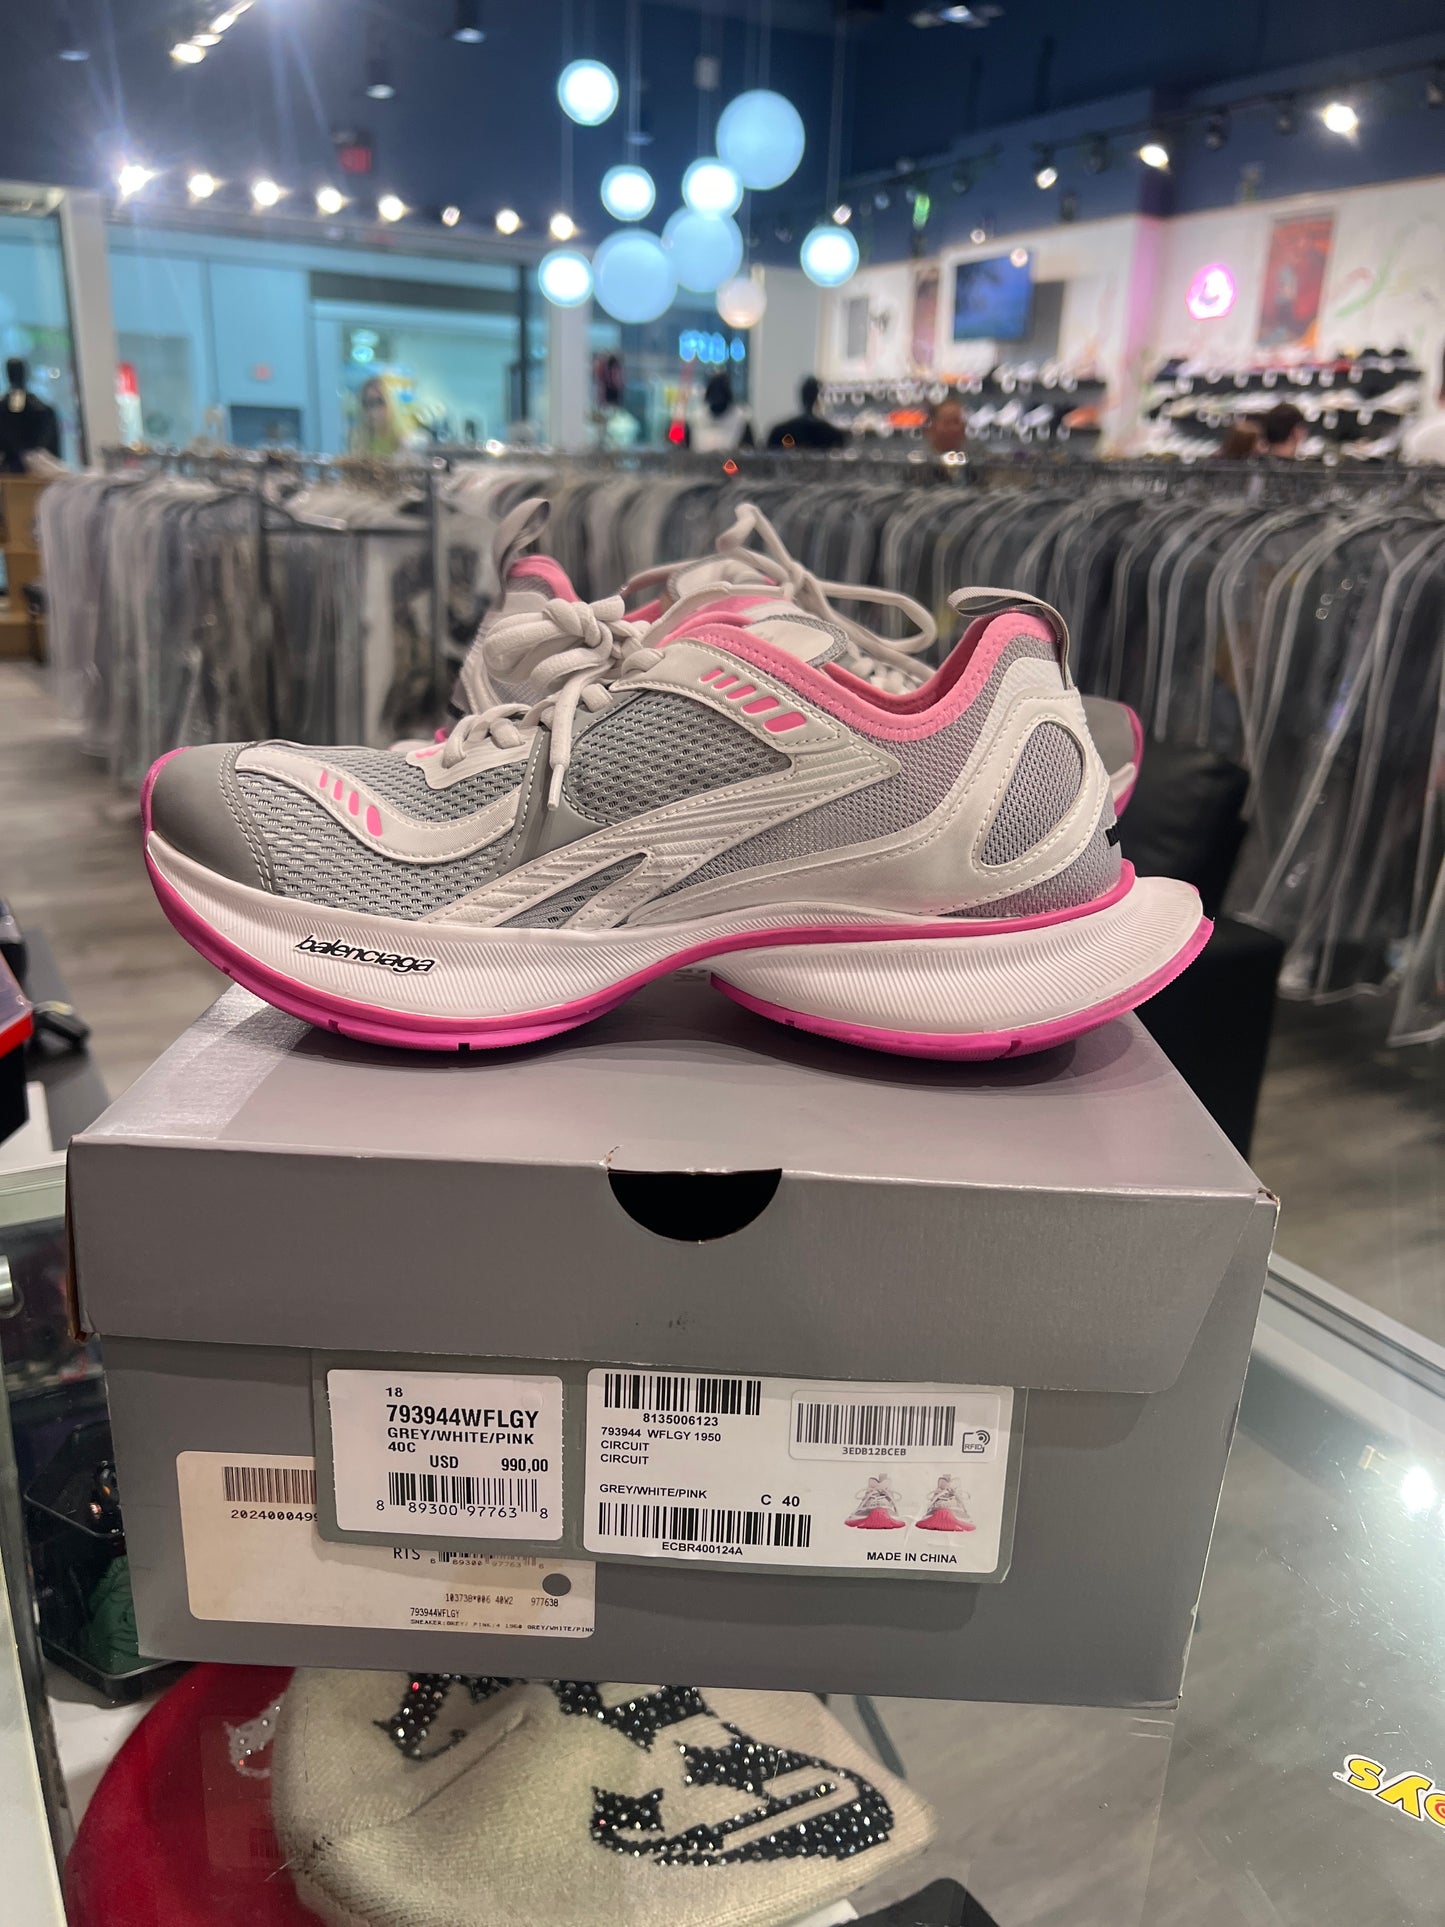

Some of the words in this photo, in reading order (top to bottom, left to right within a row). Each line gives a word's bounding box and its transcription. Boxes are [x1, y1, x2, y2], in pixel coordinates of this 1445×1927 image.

[295, 934, 436, 973] balenciaga
[385, 1387, 403, 1397] 18
[386, 1404, 539, 1428] 793944WFLGY
[642, 1413, 719, 1426] 8135006123
[387, 1427, 535, 1445] GREY/WHITE/PINK
[601, 1426, 642, 1438] 793944
[647, 1429, 692, 1441] WFLGY
[694, 1432, 722, 1442] 1950
[388, 1441, 416, 1453] 40C
[600, 1440, 650, 1452] CIRCUIT
[429, 1455, 459, 1469] USD
[501, 1458, 549, 1473] 990,00
[600, 1453, 650, 1465] CIRCUIT
[599, 1483, 708, 1499] GREY/WHITE/PINK
[760, 1494, 772, 1506] C
[782, 1495, 801, 1507] 40
[376, 1500, 385, 1511] 8
[408, 1502, 458, 1516] 89300
[467, 1505, 518, 1519] 97763
[539, 1508, 548, 1519] 8
[662, 1541, 744, 1556] ECBR400124A
[866, 1551, 902, 1562] MADE
[905, 1552, 917, 1562] IN
[919, 1553, 957, 1564] CHINA
[530, 1597, 559, 1608] 977638
[410, 1607, 460, 1619] 793944WFLGY
